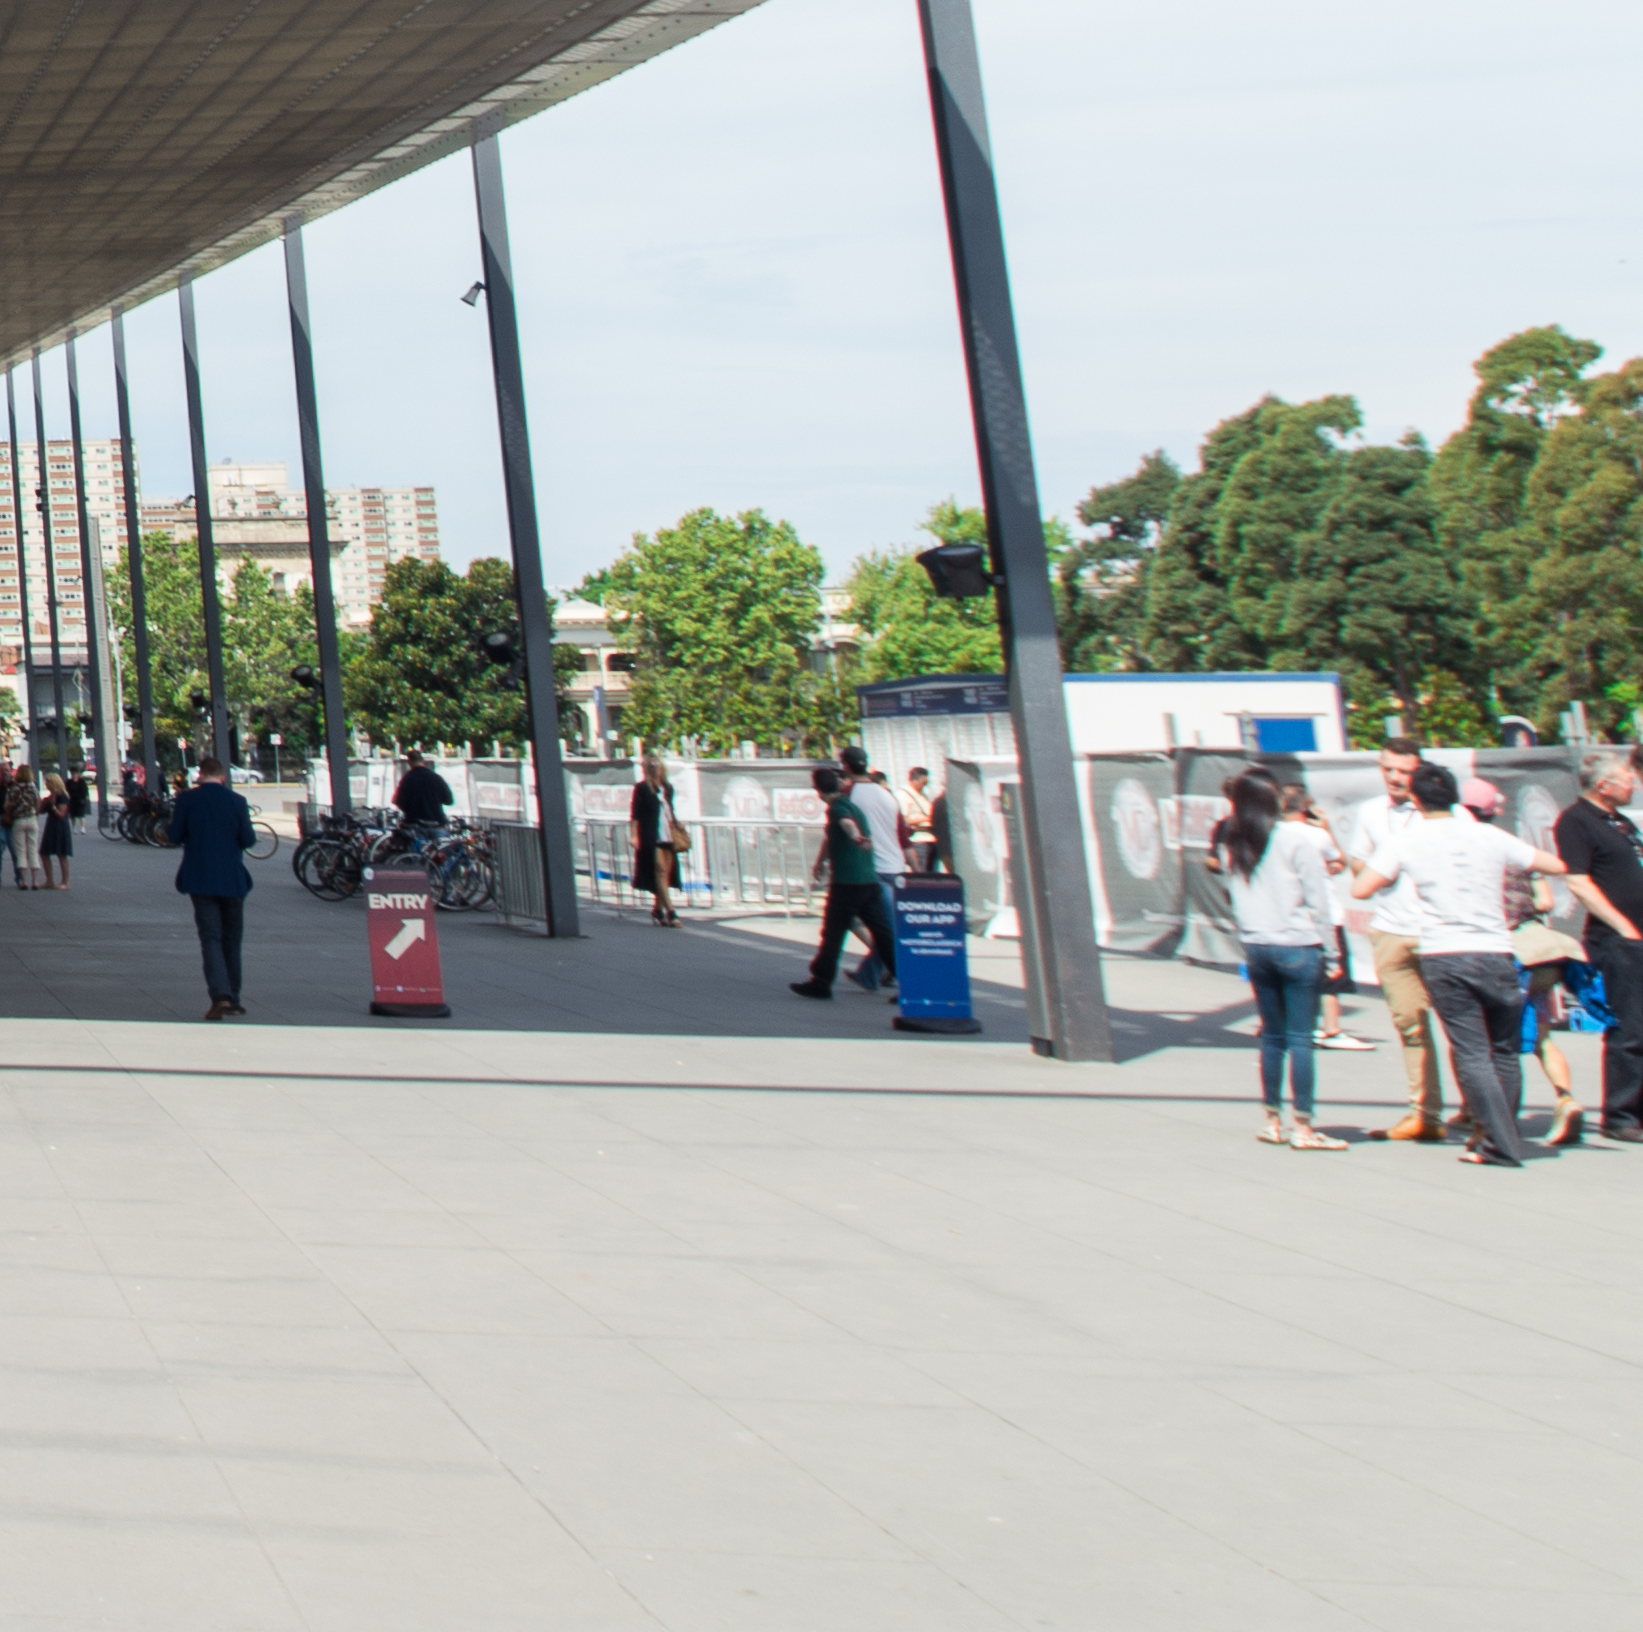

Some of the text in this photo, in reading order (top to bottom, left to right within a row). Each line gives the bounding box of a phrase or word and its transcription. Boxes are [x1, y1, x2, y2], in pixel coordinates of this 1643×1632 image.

[368, 893, 429, 909] ENTRY
[897, 901, 963, 913] DOWNLOAD
[904, 913, 957, 925] OUR APP
